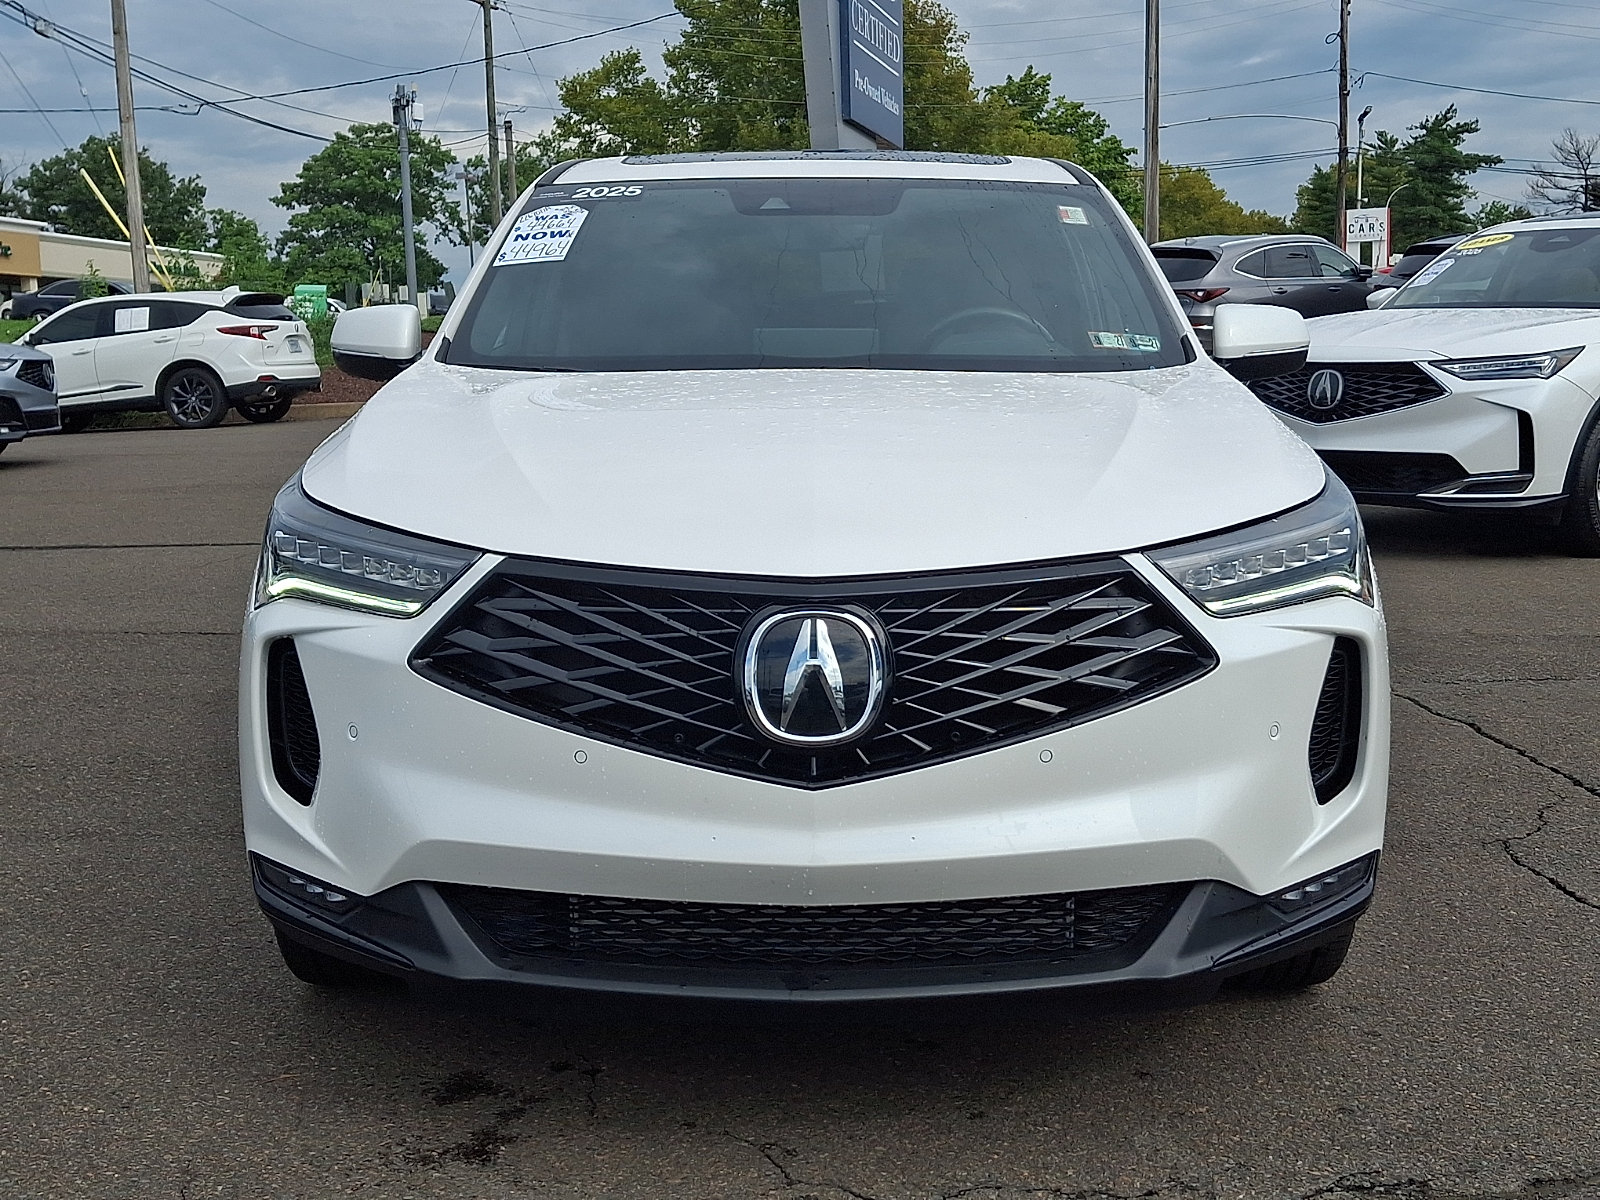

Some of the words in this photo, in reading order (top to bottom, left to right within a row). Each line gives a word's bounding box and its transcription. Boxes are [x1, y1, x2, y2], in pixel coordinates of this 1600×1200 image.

[851, 0, 900, 62] CERTIFIED
[571, 185, 644, 199] 2025
[535, 213, 570, 221] WAS
[1348, 222, 1386, 234] CARS
[513, 229, 570, 243] NOW
